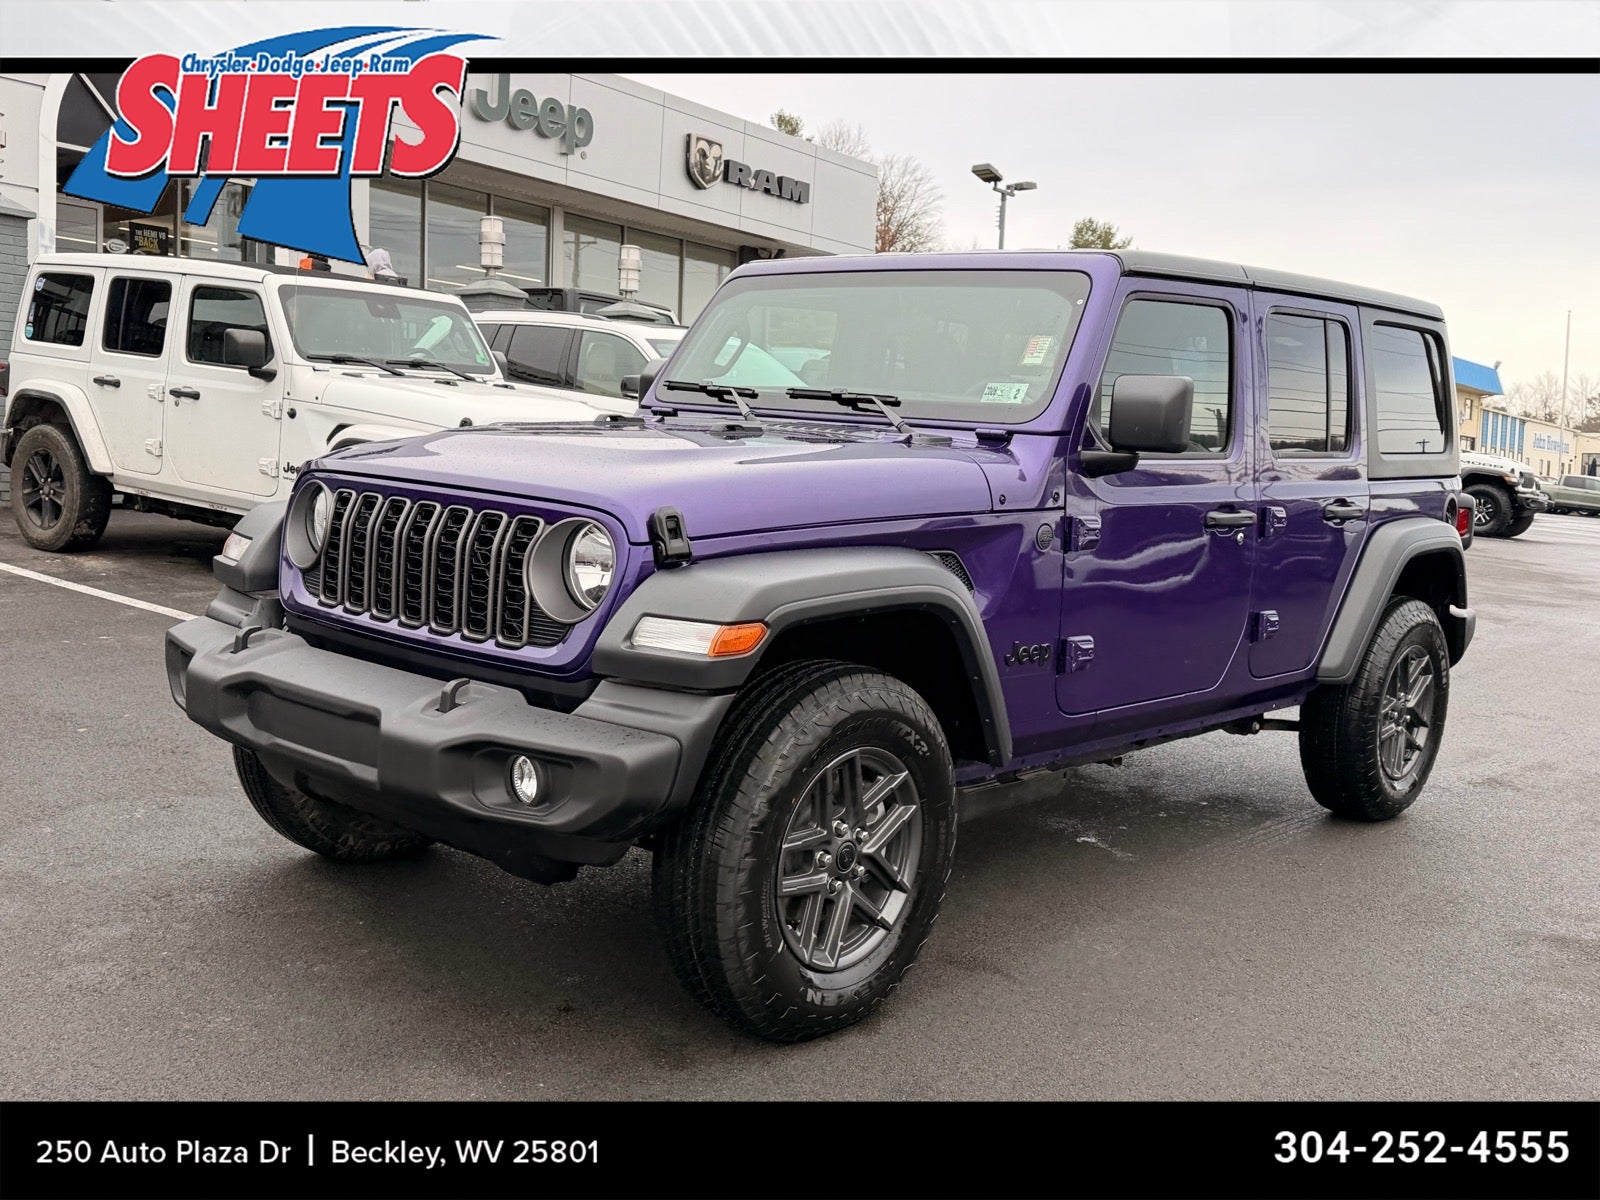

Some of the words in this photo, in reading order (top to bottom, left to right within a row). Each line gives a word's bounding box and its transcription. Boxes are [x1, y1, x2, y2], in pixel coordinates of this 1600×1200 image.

[470, 72, 594, 155] Jeep
[723, 159, 811, 204] RAM
[139, 236, 159, 248] BACK
[1005, 640, 1051, 667] Jeep
